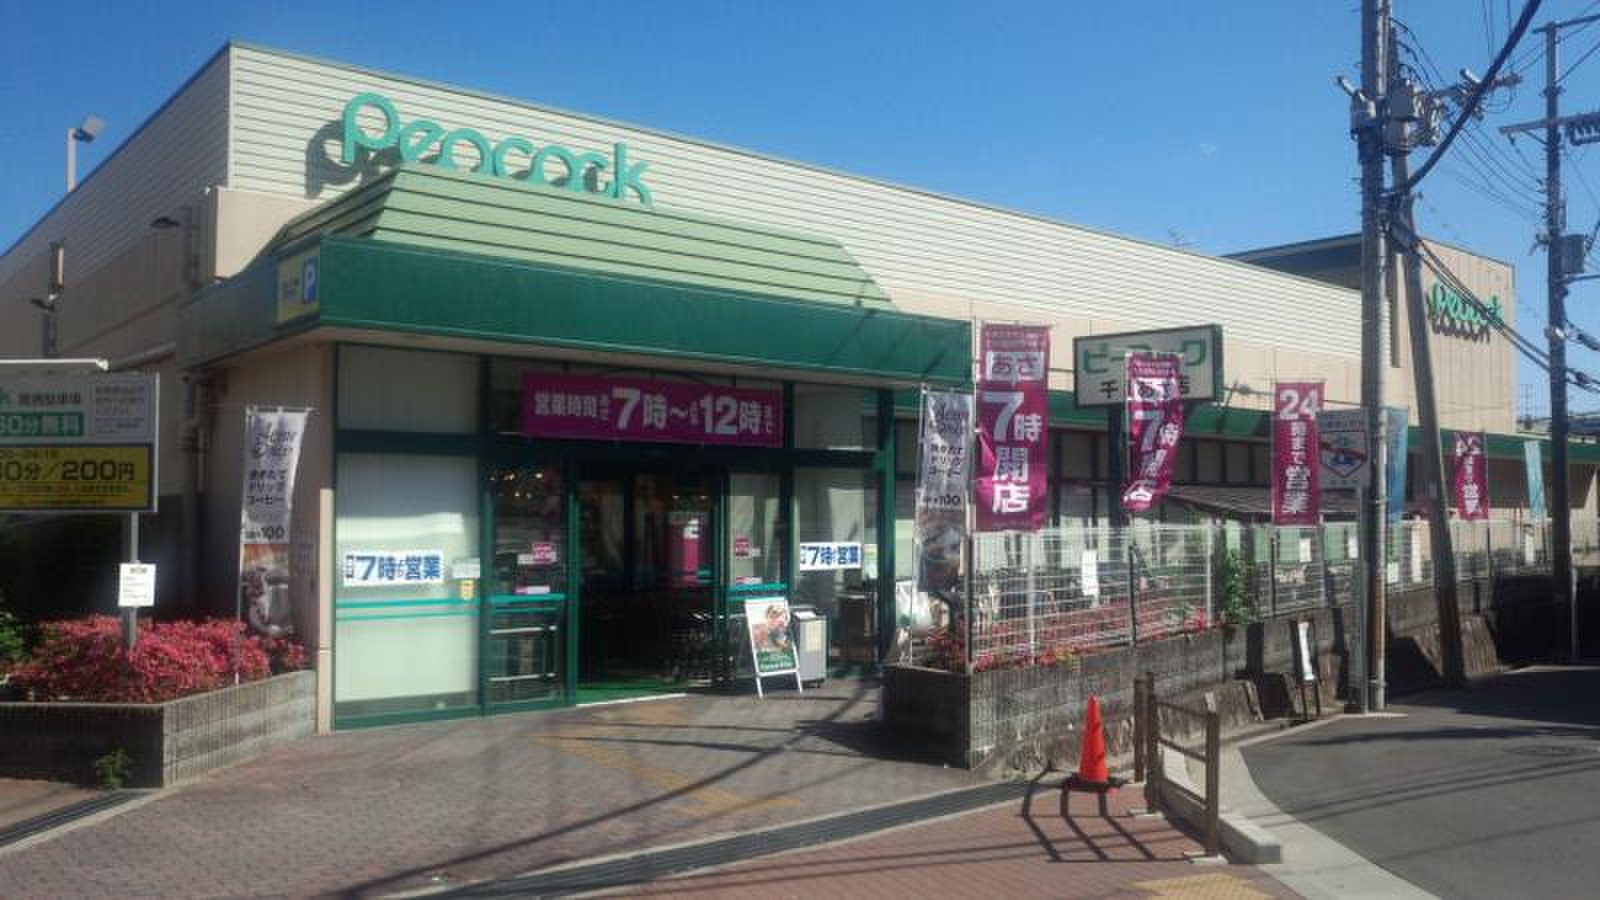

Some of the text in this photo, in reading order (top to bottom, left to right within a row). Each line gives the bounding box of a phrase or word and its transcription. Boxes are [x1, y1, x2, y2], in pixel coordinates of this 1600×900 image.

[342, 92, 653, 205] Peacock
[982, 391, 1042, 442] 7時
[1279, 389, 1320, 420] 24
[0, 461, 135, 480] 0分/200円
[991, 447, 1031, 514] 開店
